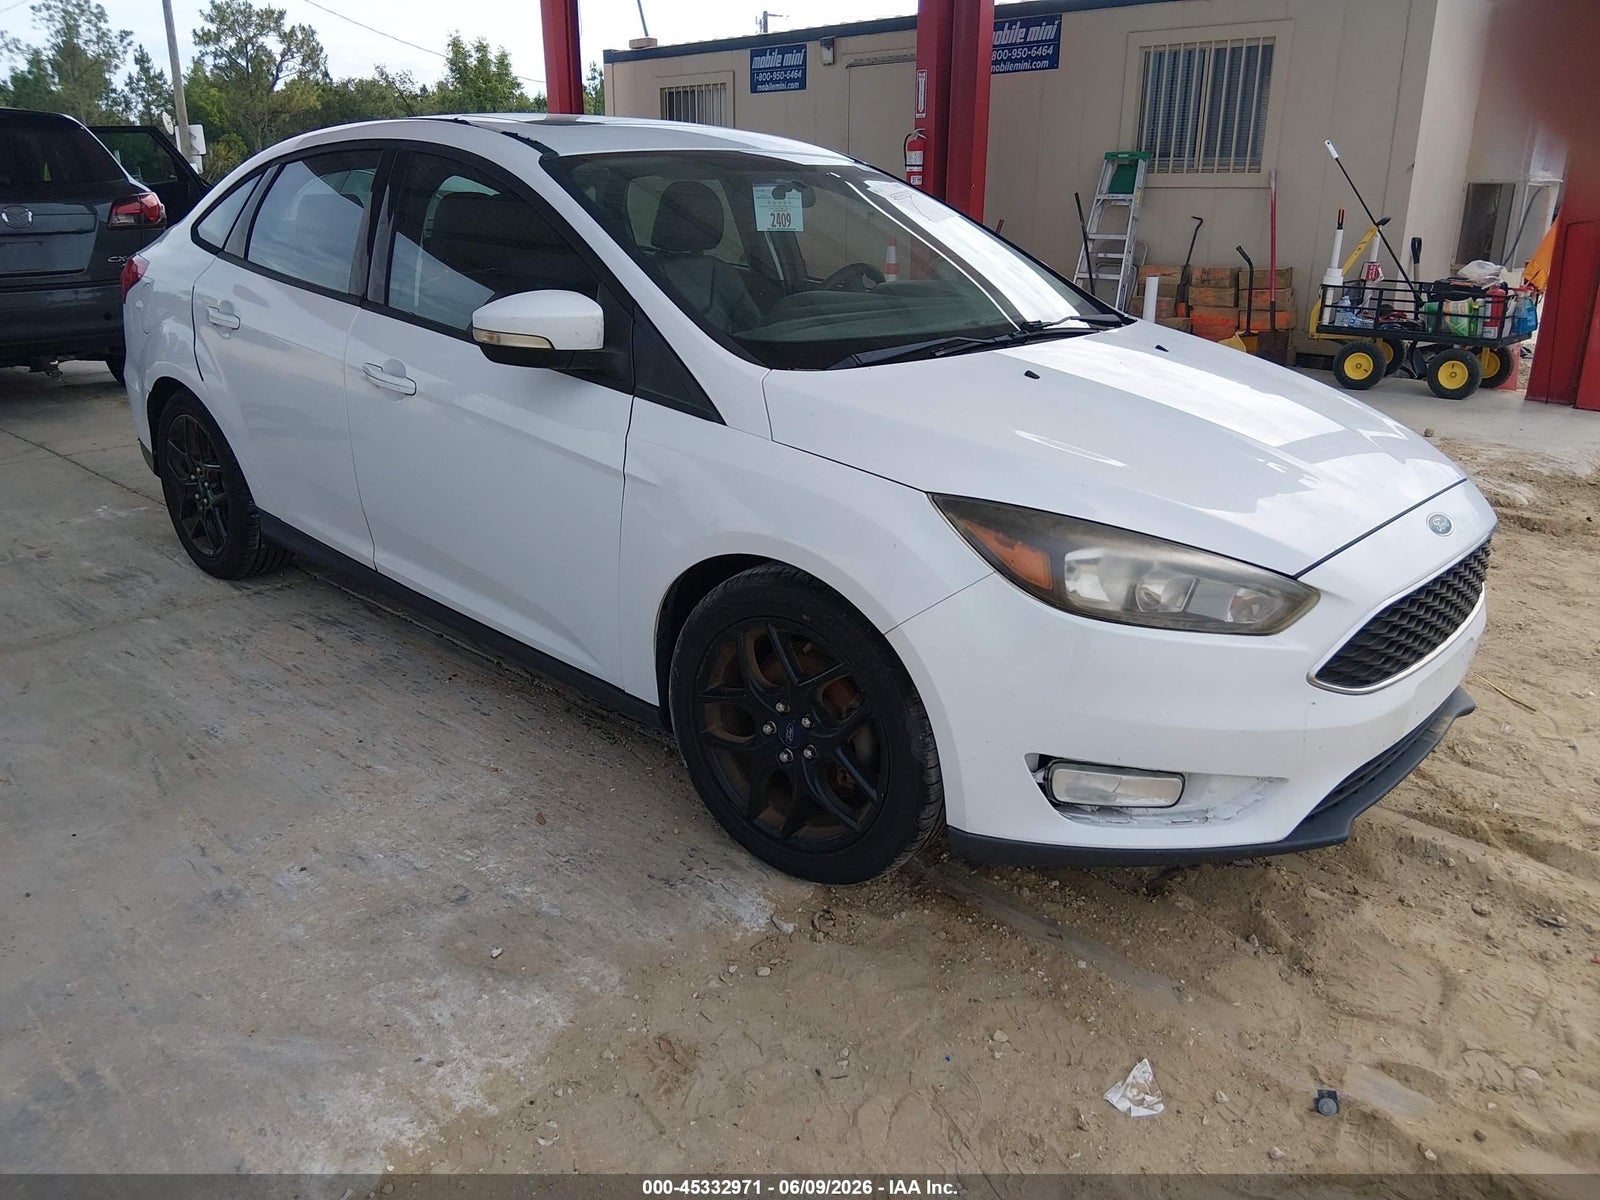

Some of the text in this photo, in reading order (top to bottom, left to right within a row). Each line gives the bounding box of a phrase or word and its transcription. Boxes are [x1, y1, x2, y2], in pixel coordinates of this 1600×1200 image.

[992, 20, 1059, 45] obile mini
[752, 49, 805, 68] mobile mini
[991, 45, 1054, 61] 800-950-6464
[754, 70, 802, 81] 1-800-950-6464
[757, 82, 800, 91] mobilemini.com
[770, 213, 791, 228] 2409
